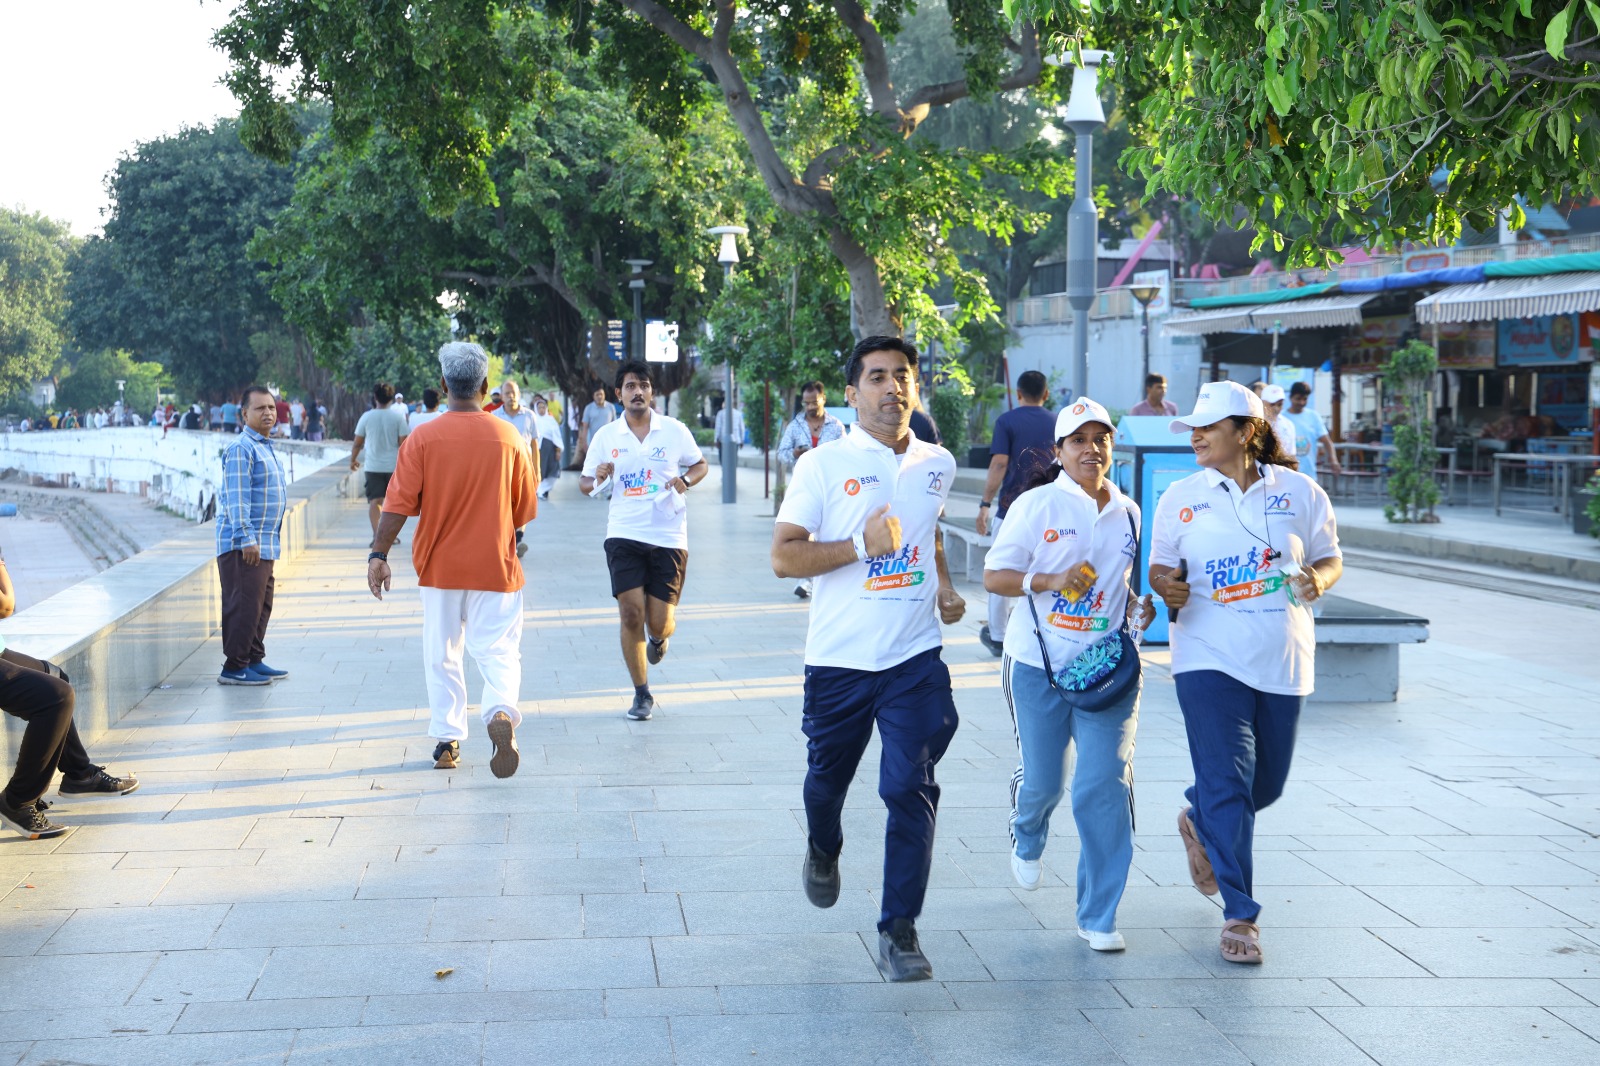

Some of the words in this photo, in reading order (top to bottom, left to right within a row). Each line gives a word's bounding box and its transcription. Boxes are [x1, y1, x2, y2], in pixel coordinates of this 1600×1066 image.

[652, 447, 666, 458] 26
[624, 478, 645, 489] RUN
[861, 475, 880, 484] BSNL
[928, 472, 944, 490] 26
[1193, 502, 1211, 512] BSNL
[1060, 528, 1078, 536] BSNL
[867, 560, 910, 578] RUN
[1205, 559, 1216, 574] 5
[1218, 555, 1239, 570] KM
[870, 578, 900, 590] Hamara
[901, 573, 920, 586] BSNL
[1212, 566, 1258, 589] RUN
[1218, 589, 1249, 602] Hamara
[1250, 579, 1275, 596] BSNL
[1051, 597, 1091, 616] RUN
[1052, 614, 1080, 628] Hamara
[1080, 618, 1103, 630] BSNL
